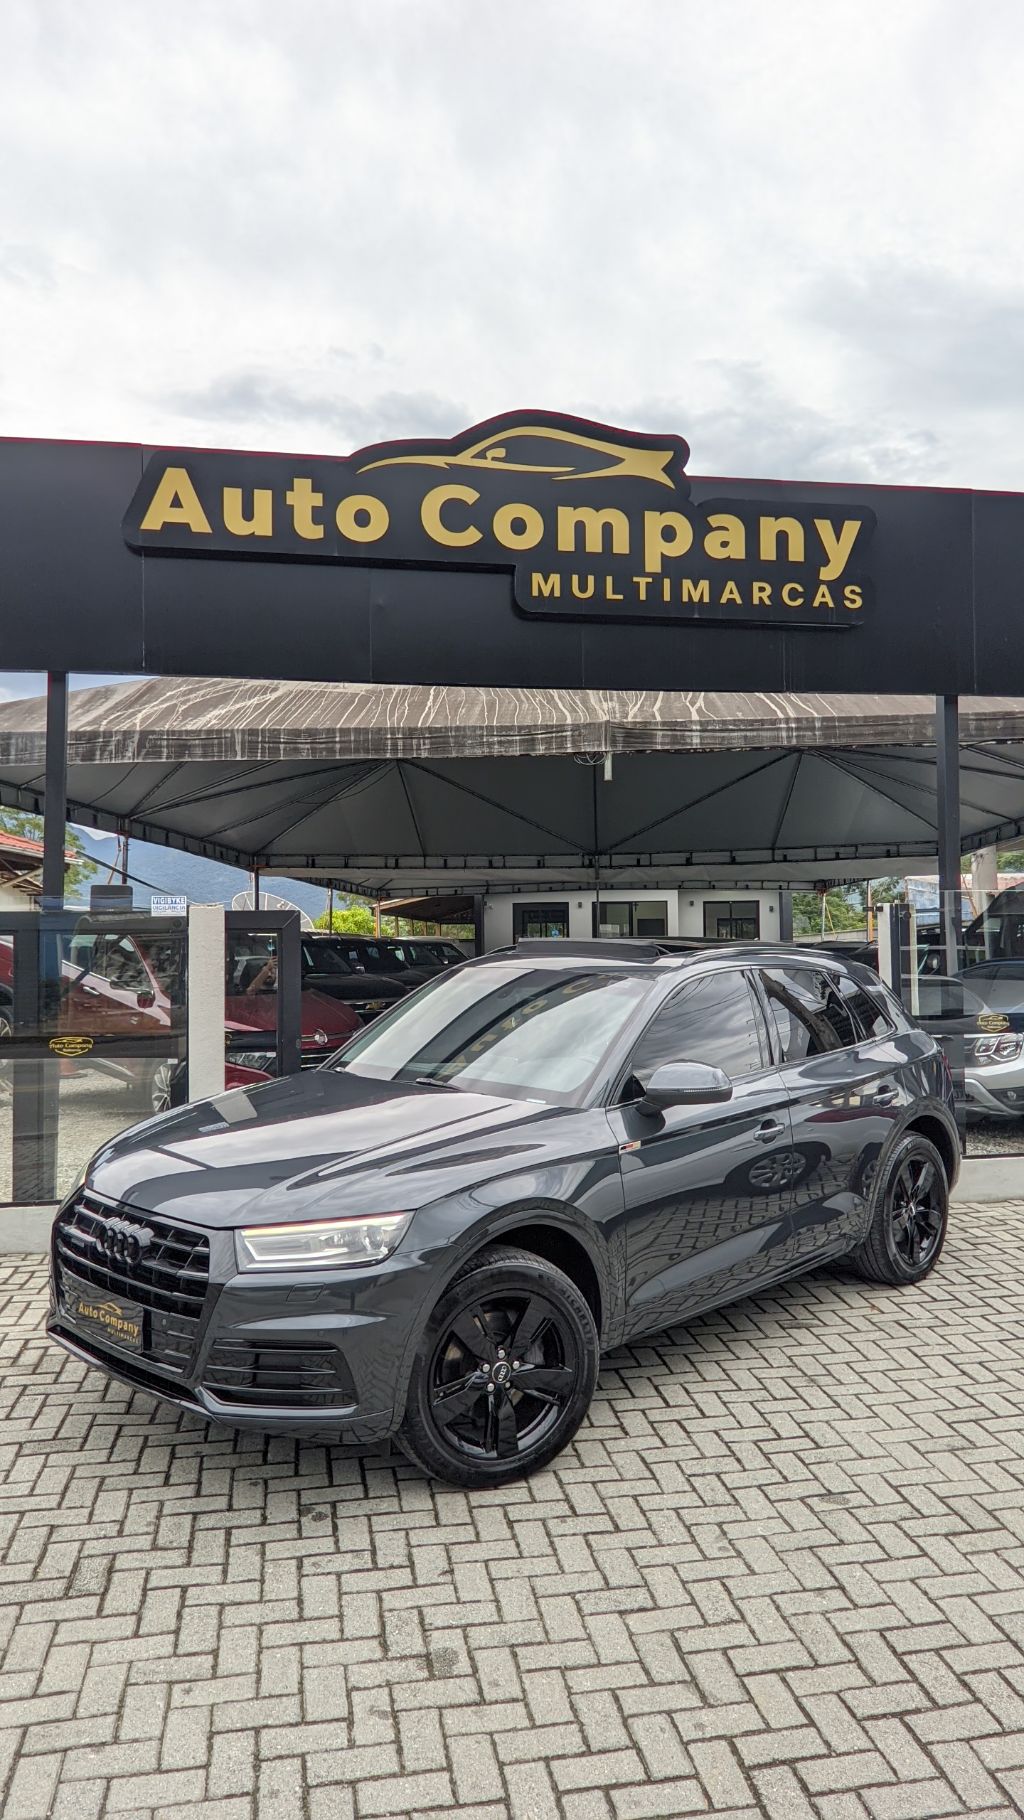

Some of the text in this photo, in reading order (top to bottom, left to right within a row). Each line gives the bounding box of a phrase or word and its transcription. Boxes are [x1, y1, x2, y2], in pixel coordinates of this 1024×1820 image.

[140, 467, 863, 582] Auto Company
[531, 573, 864, 609] MULTIMARCAS
[78, 1301, 139, 1337] Auto Company
